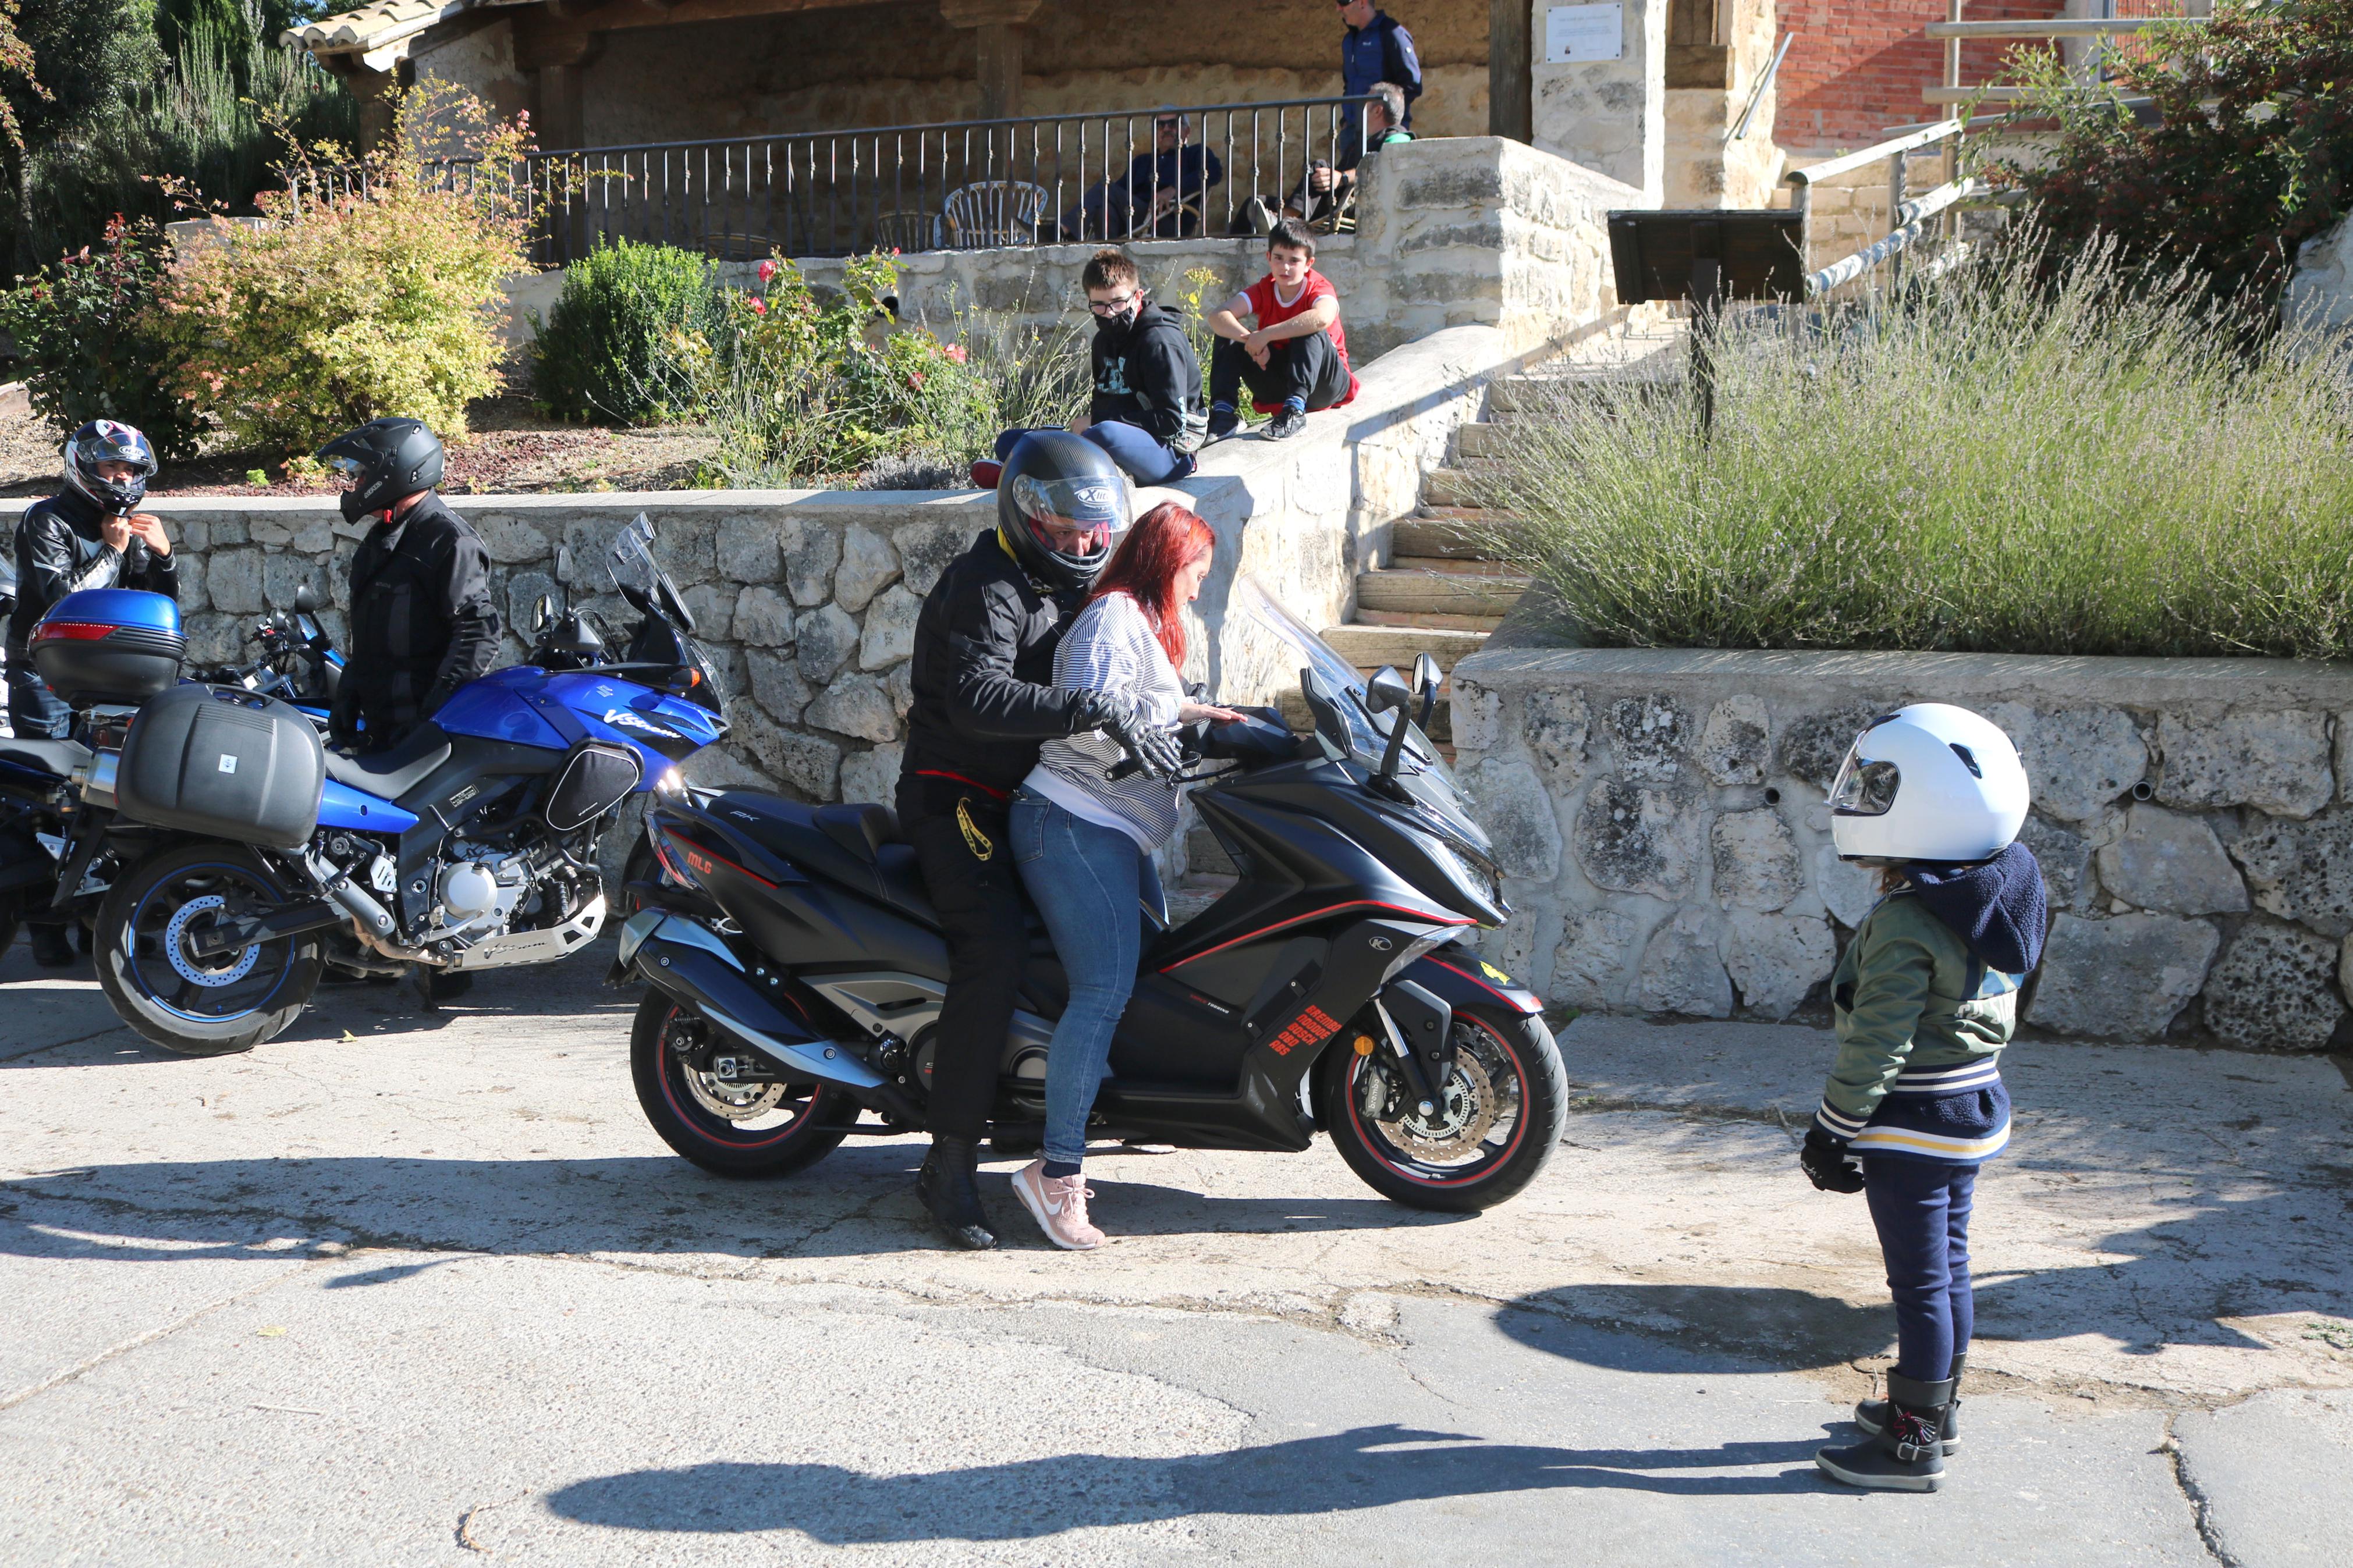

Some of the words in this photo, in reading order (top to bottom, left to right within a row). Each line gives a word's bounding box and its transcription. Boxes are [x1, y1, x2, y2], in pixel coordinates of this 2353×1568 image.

[1305, 1005, 1343, 1032] BREMBO
[1278, 1031, 1300, 1047] OBD
[1287, 1022, 1318, 1046] BOSCH
[1269, 1040, 1290, 1056] ABS
[1368, 1079, 1379, 1109] brembo
